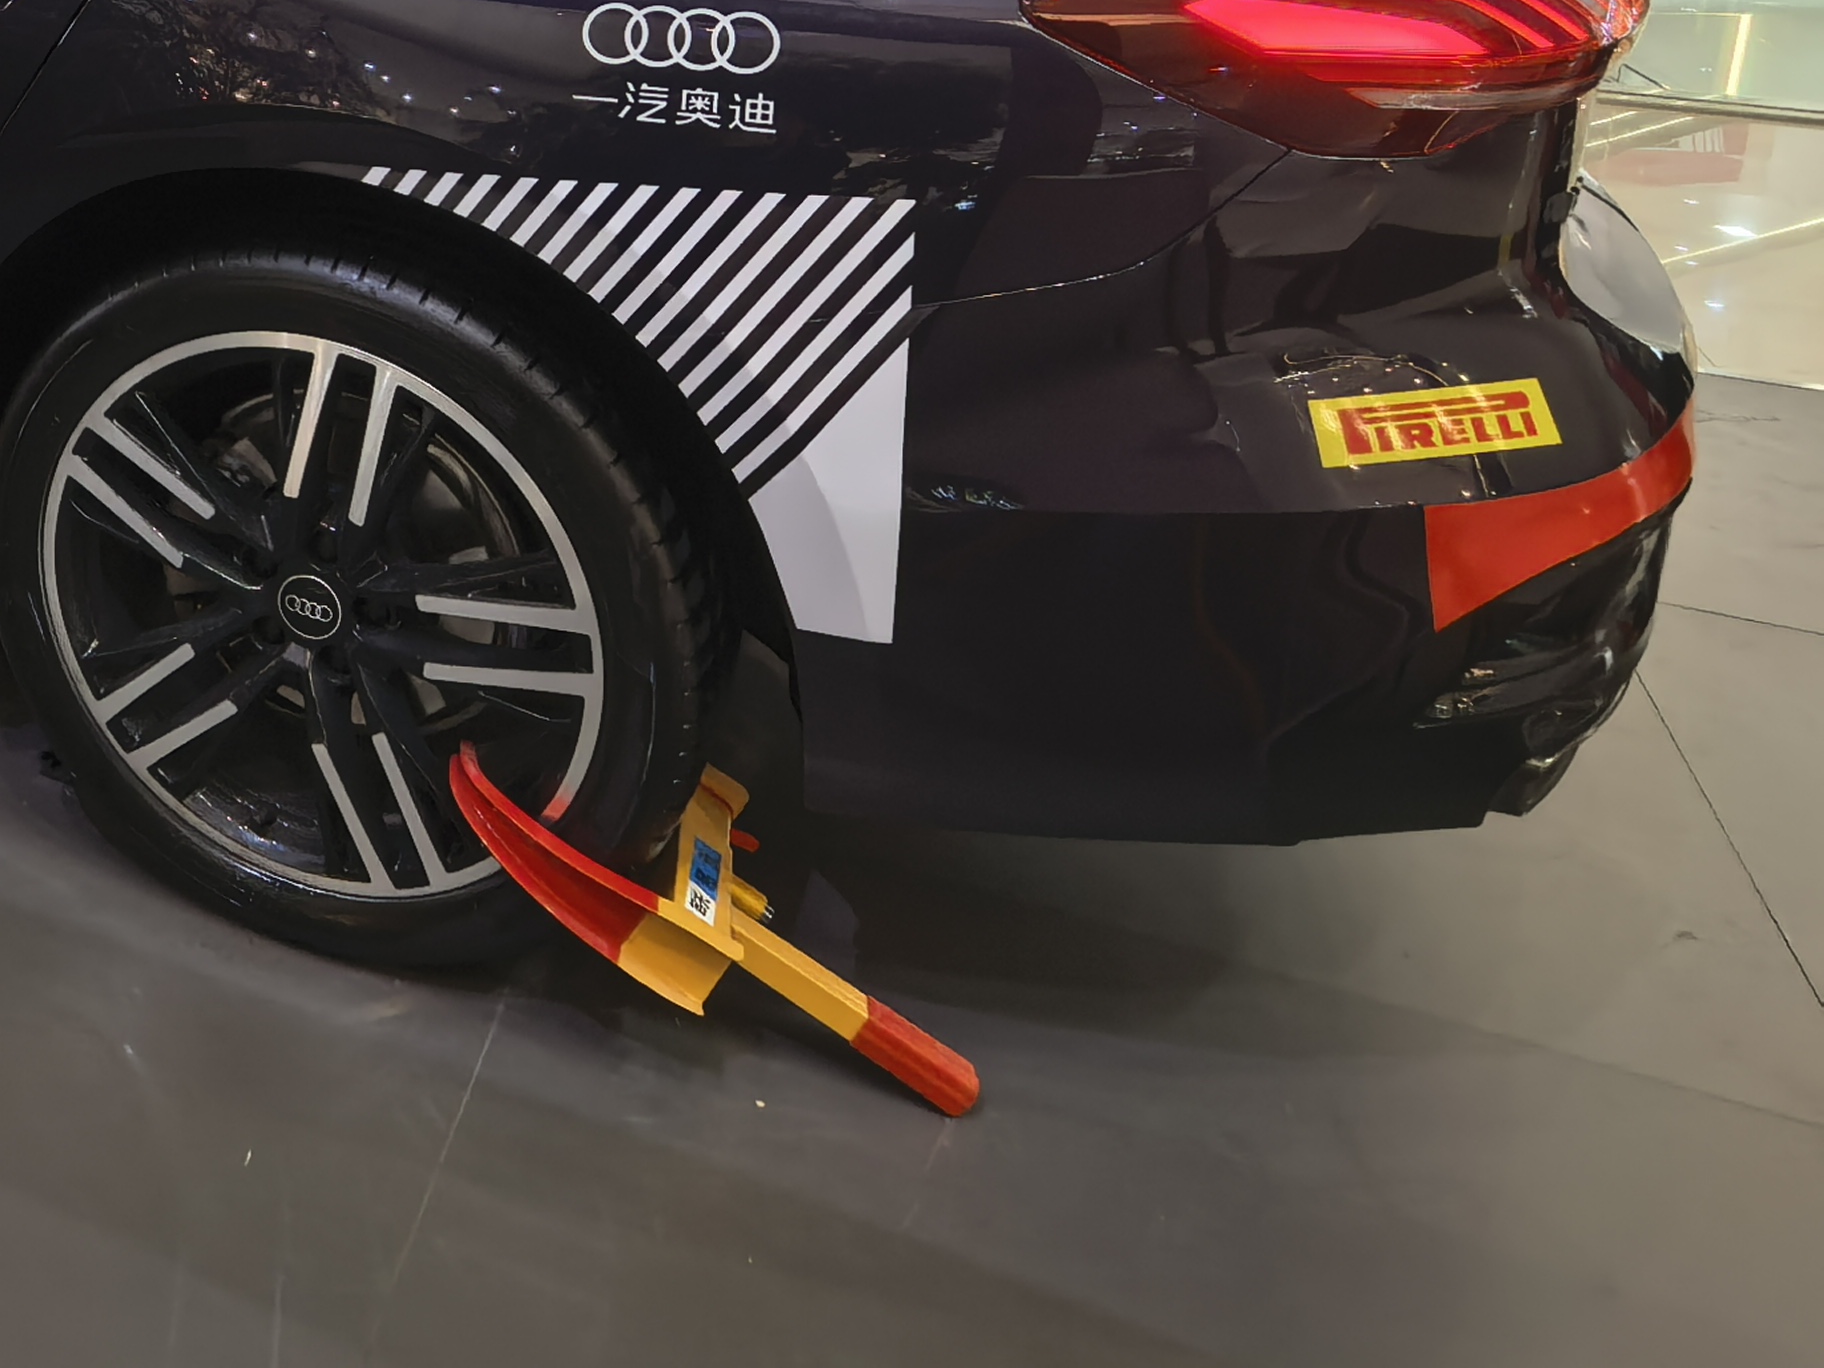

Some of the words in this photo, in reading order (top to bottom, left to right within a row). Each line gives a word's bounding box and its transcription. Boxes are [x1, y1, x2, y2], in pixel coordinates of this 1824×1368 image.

[572, 81, 778, 135] 一汽奥迪
[1337, 390, 1539, 456] PIRELLI
